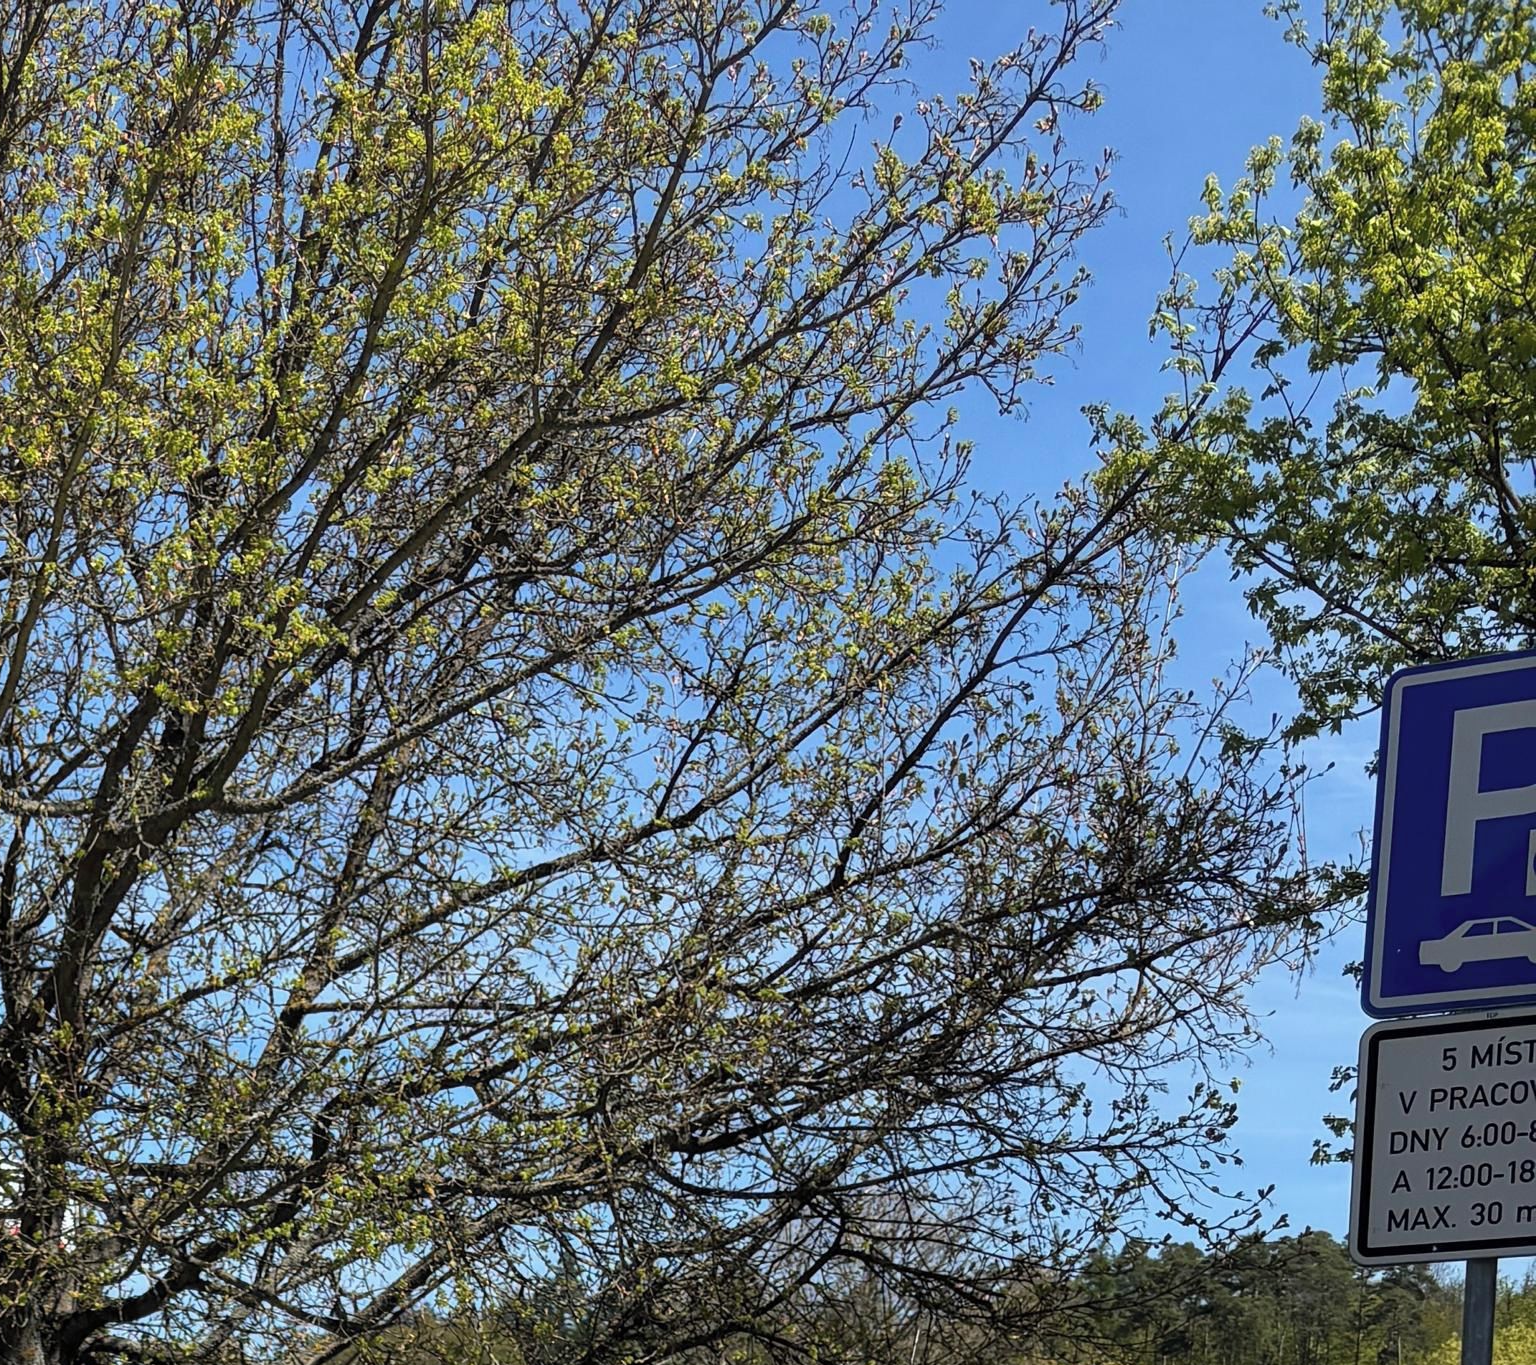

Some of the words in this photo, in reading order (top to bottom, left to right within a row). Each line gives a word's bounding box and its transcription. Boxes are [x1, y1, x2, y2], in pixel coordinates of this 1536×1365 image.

[1441, 699, 1536, 896] P
[1442, 1047, 1457, 1071] 5
[1399, 1091, 1417, 1114] V
[1390, 1127, 1450, 1154] DNY
[1391, 1170, 1411, 1193] A
[1426, 1159, 1535, 1190] 12:00-18
[1387, 1205, 1458, 1232] MAX.
[1470, 1201, 1503, 1226] 30
